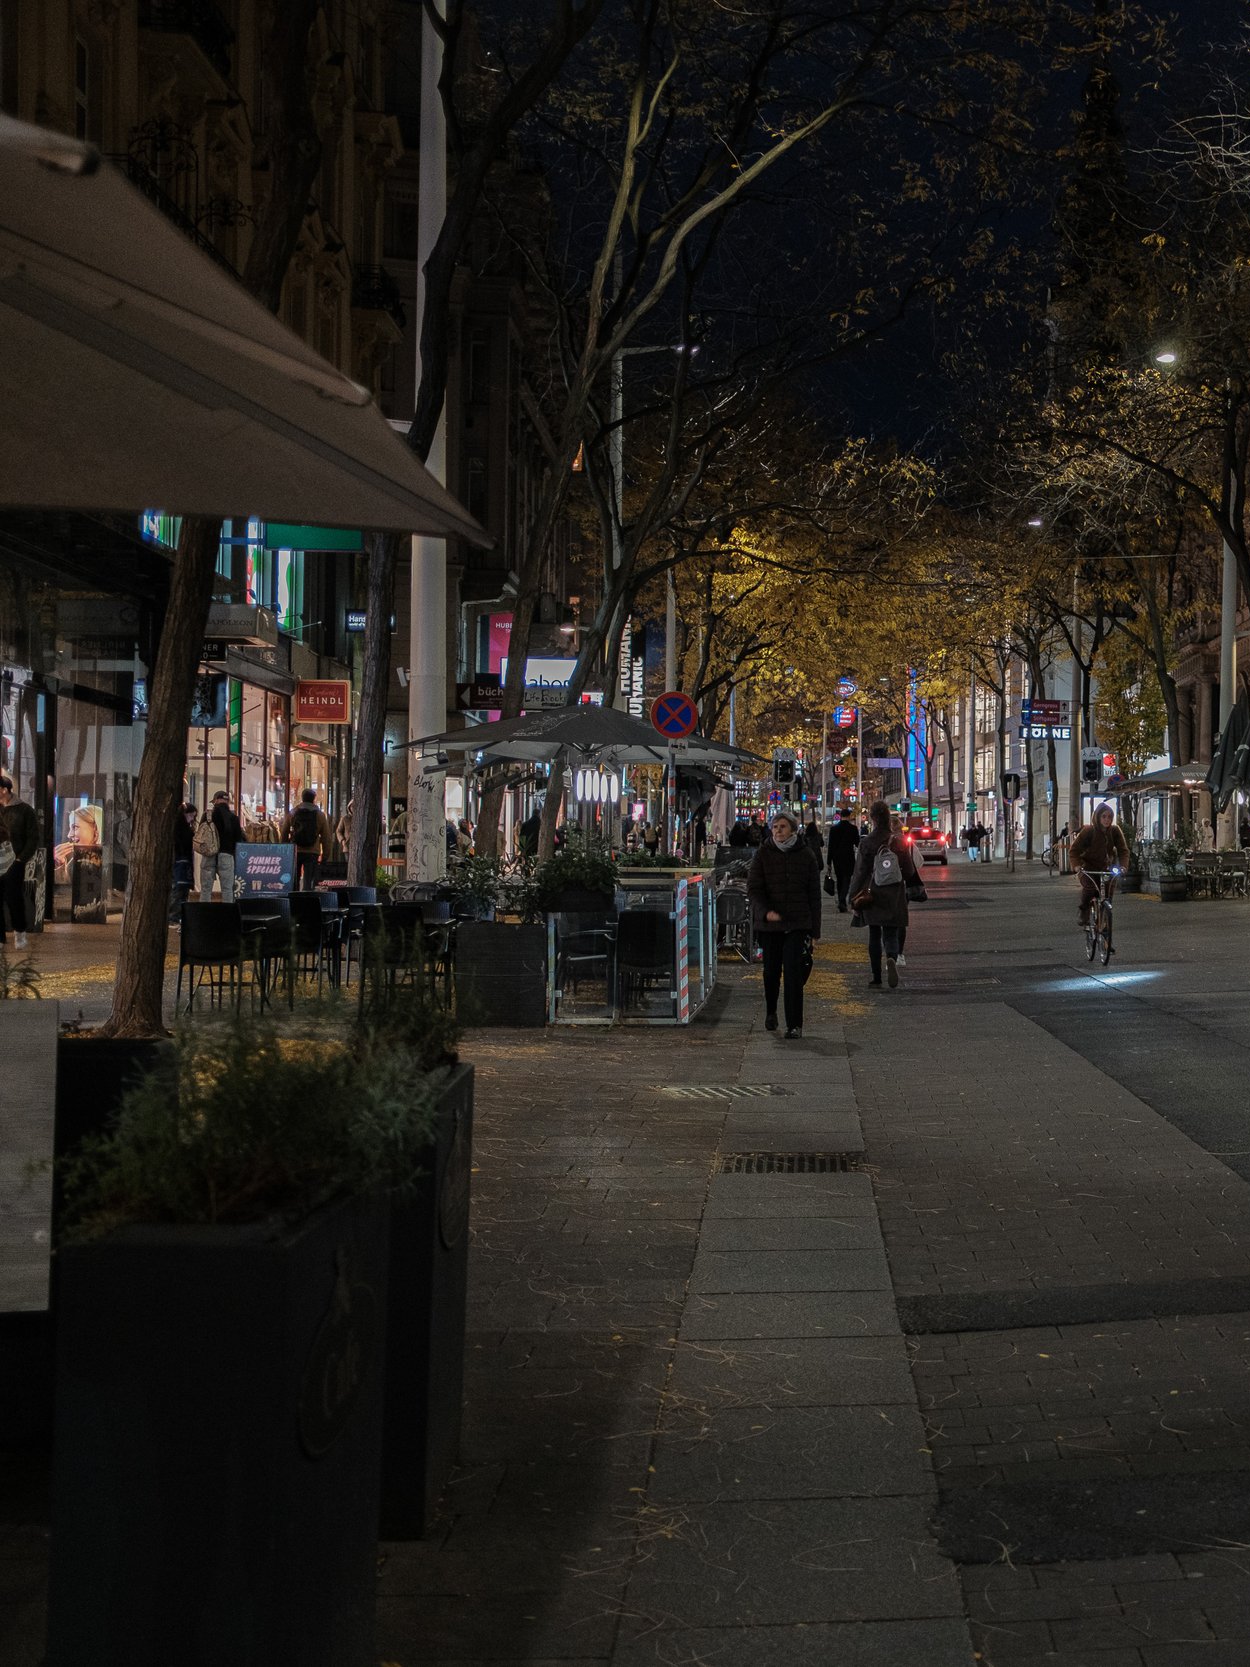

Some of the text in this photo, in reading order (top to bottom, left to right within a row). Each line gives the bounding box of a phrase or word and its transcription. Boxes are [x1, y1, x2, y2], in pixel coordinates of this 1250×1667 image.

[478, 686, 504, 696] büch
[300, 697, 344, 705] HEINDL
[247, 856, 282, 865] SUMMER
[246, 865, 281, 875] SPECIALS
